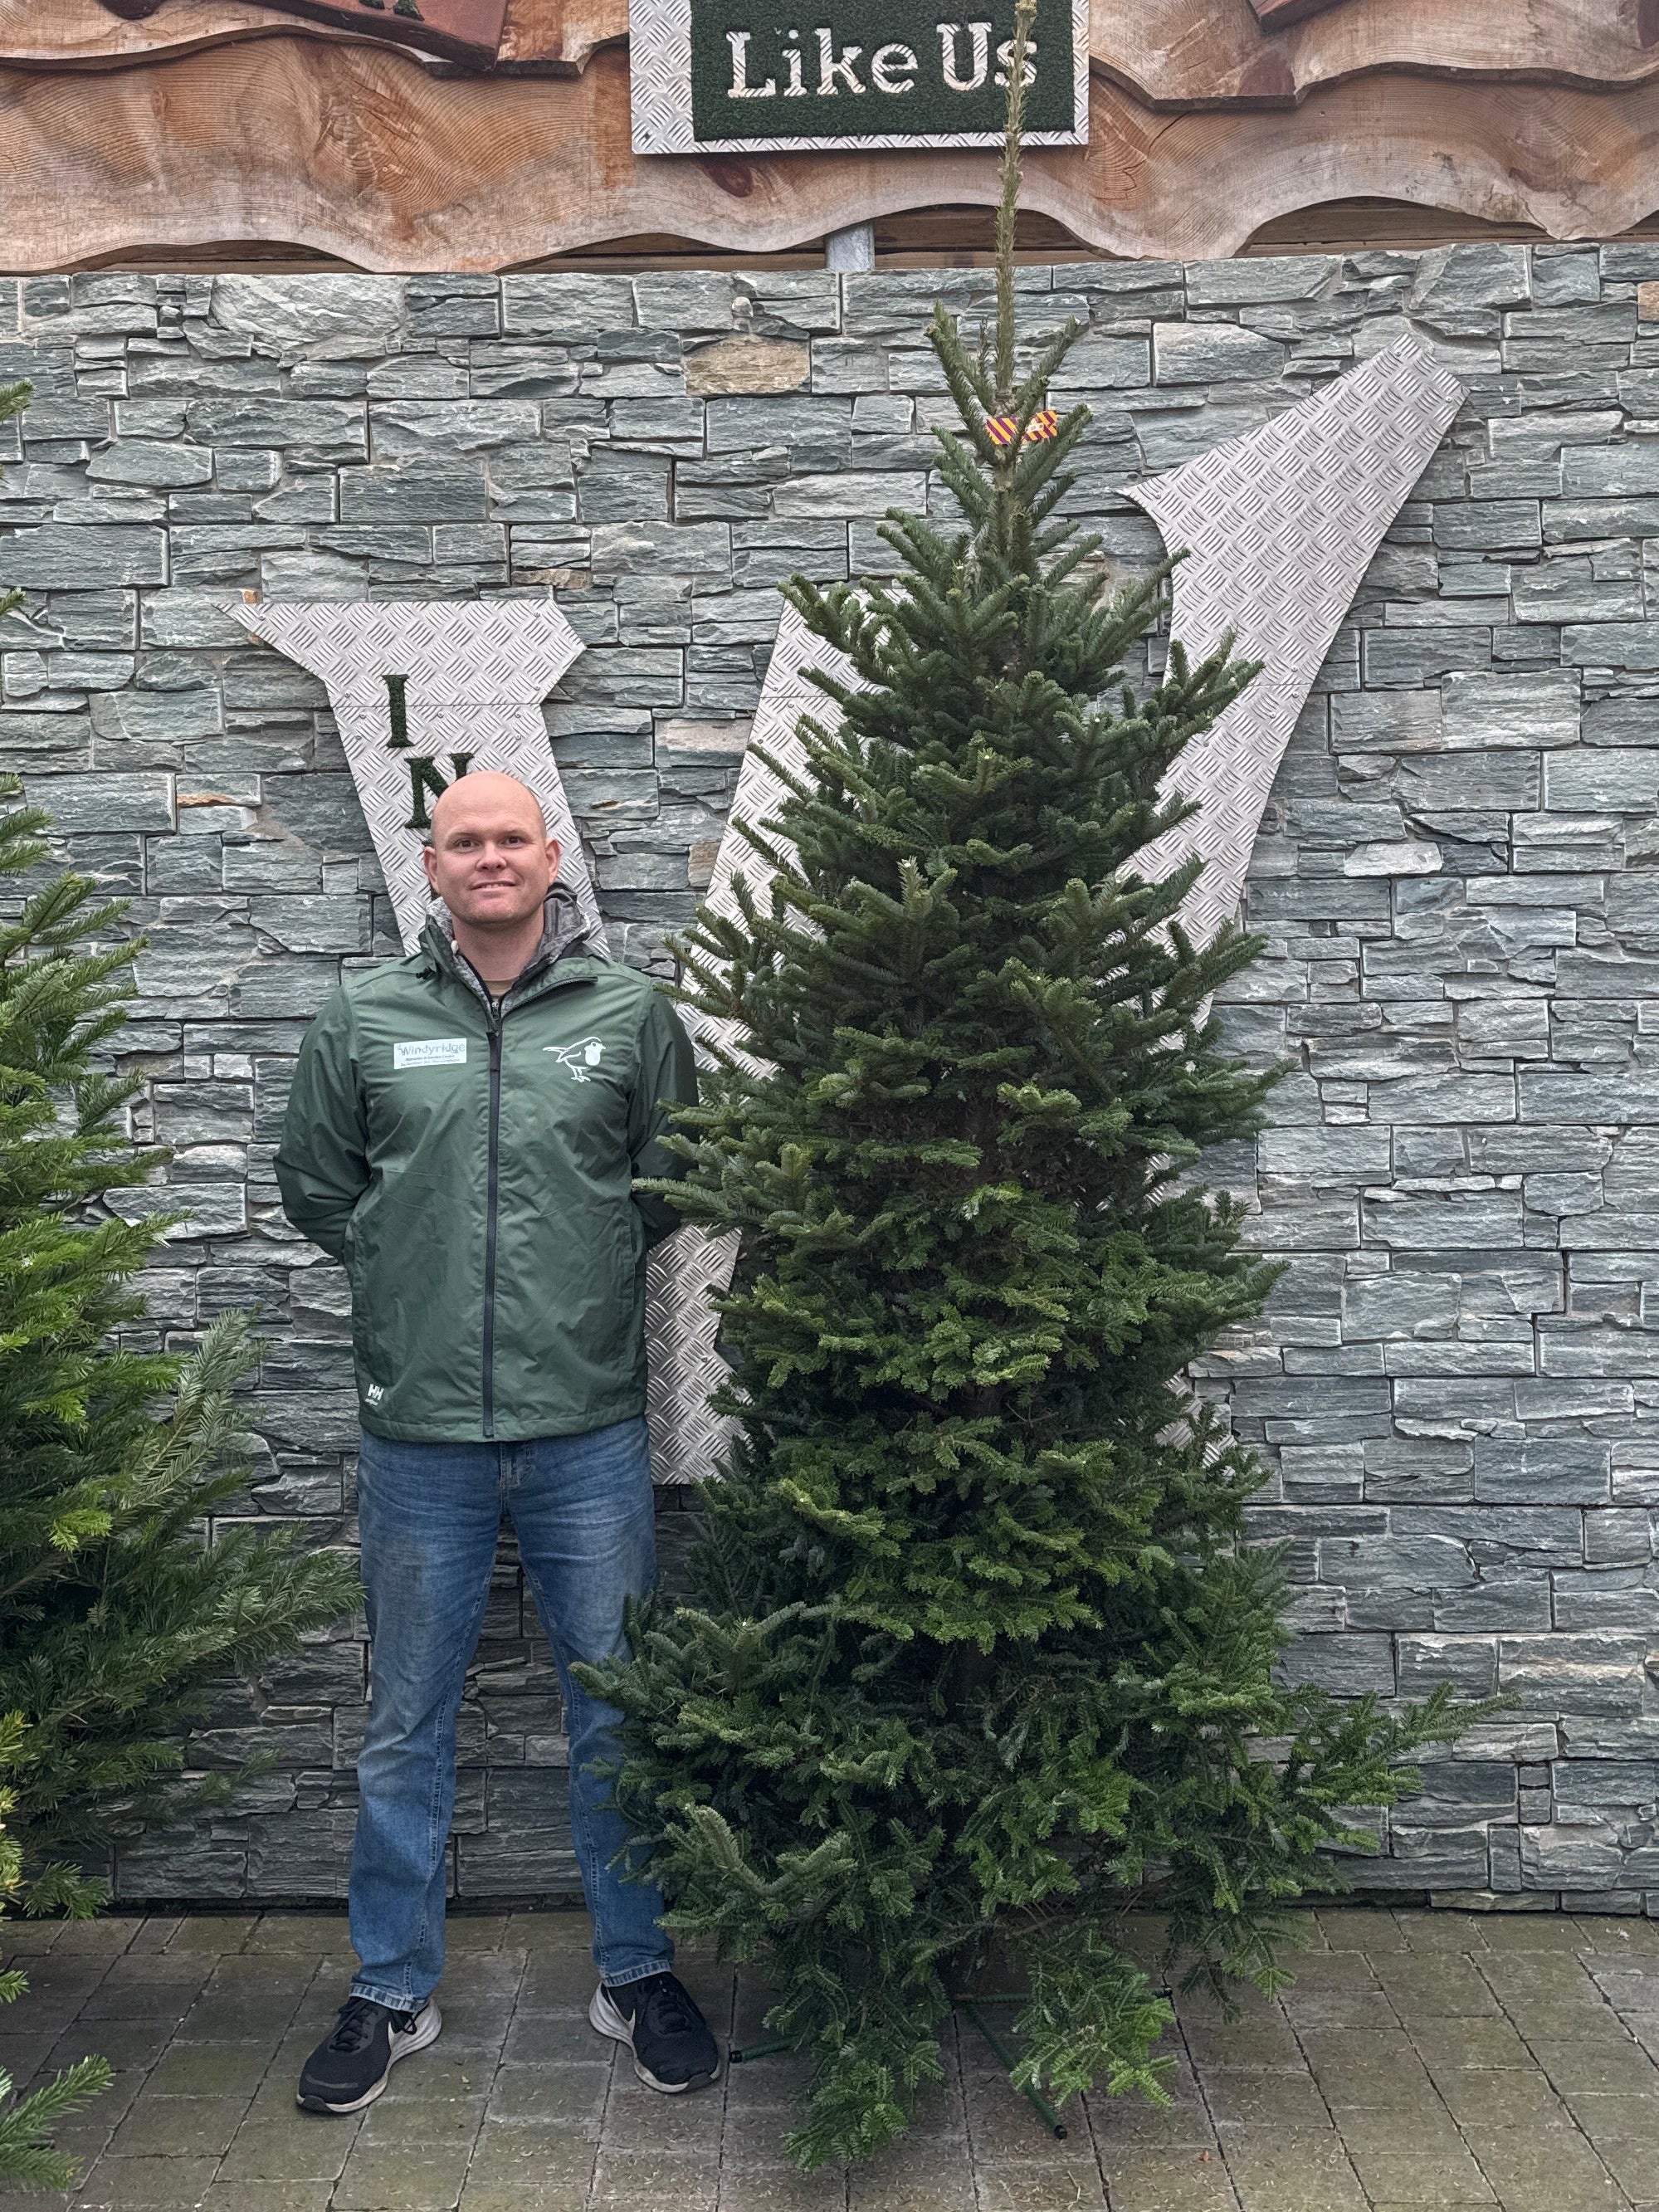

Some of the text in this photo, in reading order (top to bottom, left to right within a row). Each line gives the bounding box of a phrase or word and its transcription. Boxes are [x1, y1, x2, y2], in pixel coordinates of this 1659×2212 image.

[726, 22, 1037, 98] Like Us
[398, 1043, 466, 1056] Windyridge
